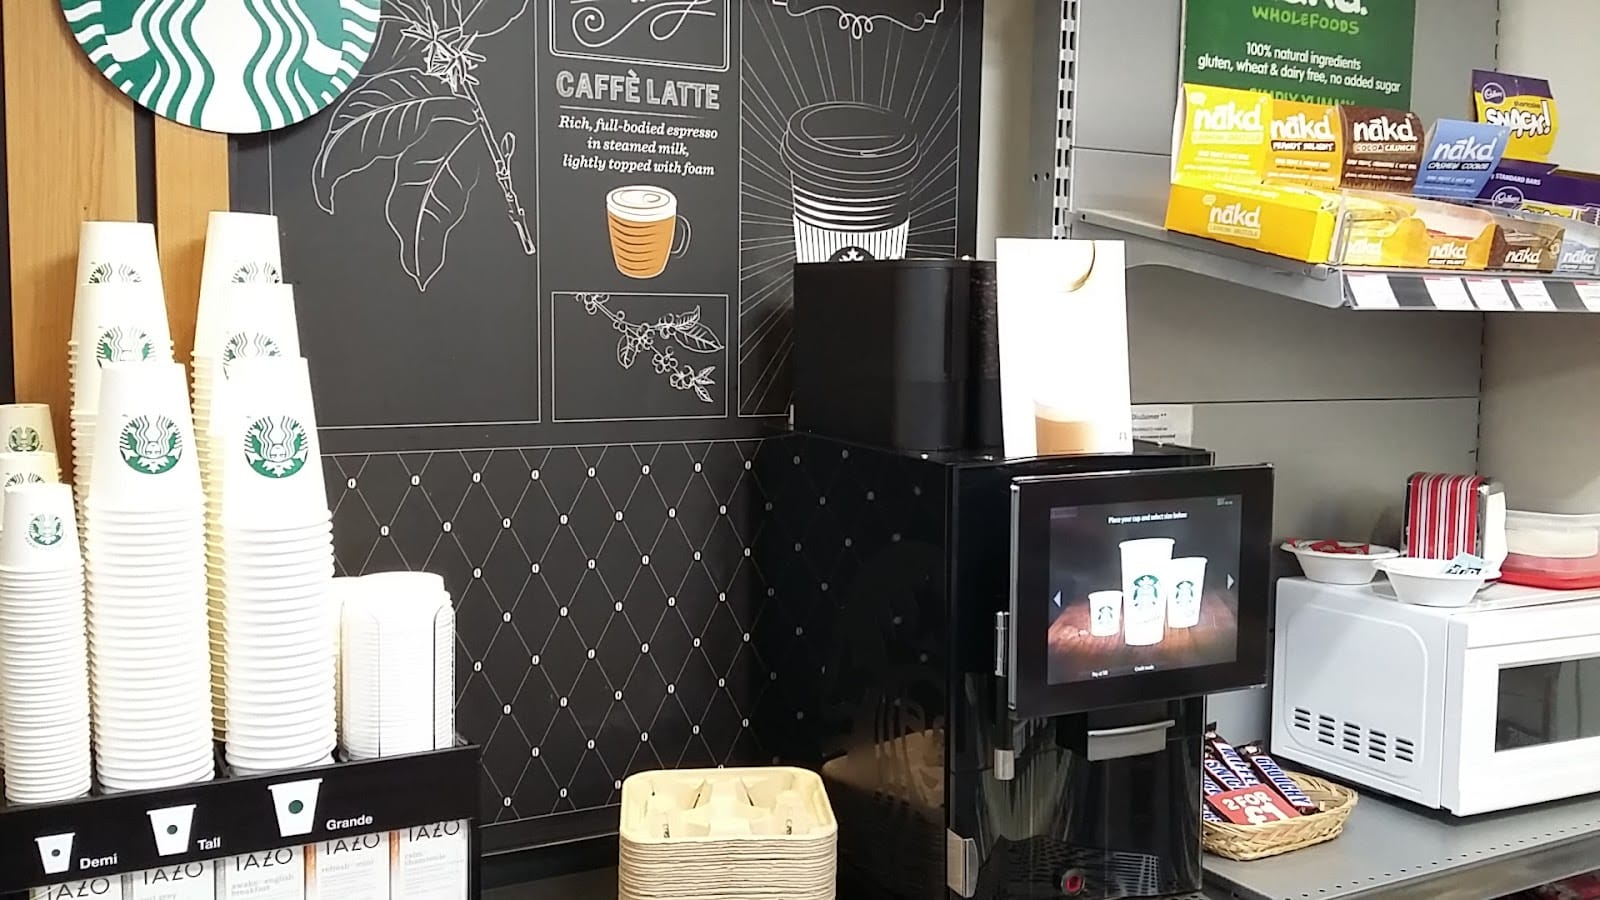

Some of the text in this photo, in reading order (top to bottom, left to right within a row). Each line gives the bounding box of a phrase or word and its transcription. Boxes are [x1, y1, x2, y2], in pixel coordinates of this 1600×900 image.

[1252, 6, 1360, 35] WHOLEFOODS
[1246, 41, 1361, 71] 100% natural ingredients
[1198, 54, 1401, 95] gluten, wheat & dairy free, no added sugar
[555, 69, 720, 110] CAFFÈ LATTE
[558, 115, 718, 139] Rich, full-bodied espresso
[587, 137, 690, 158] in steamed milk,
[562, 154, 715, 177] lightly topped with foam
[326, 814, 373, 831] Grande
[197, 836, 221, 851] Tall
[80, 852, 118, 870] Demi
